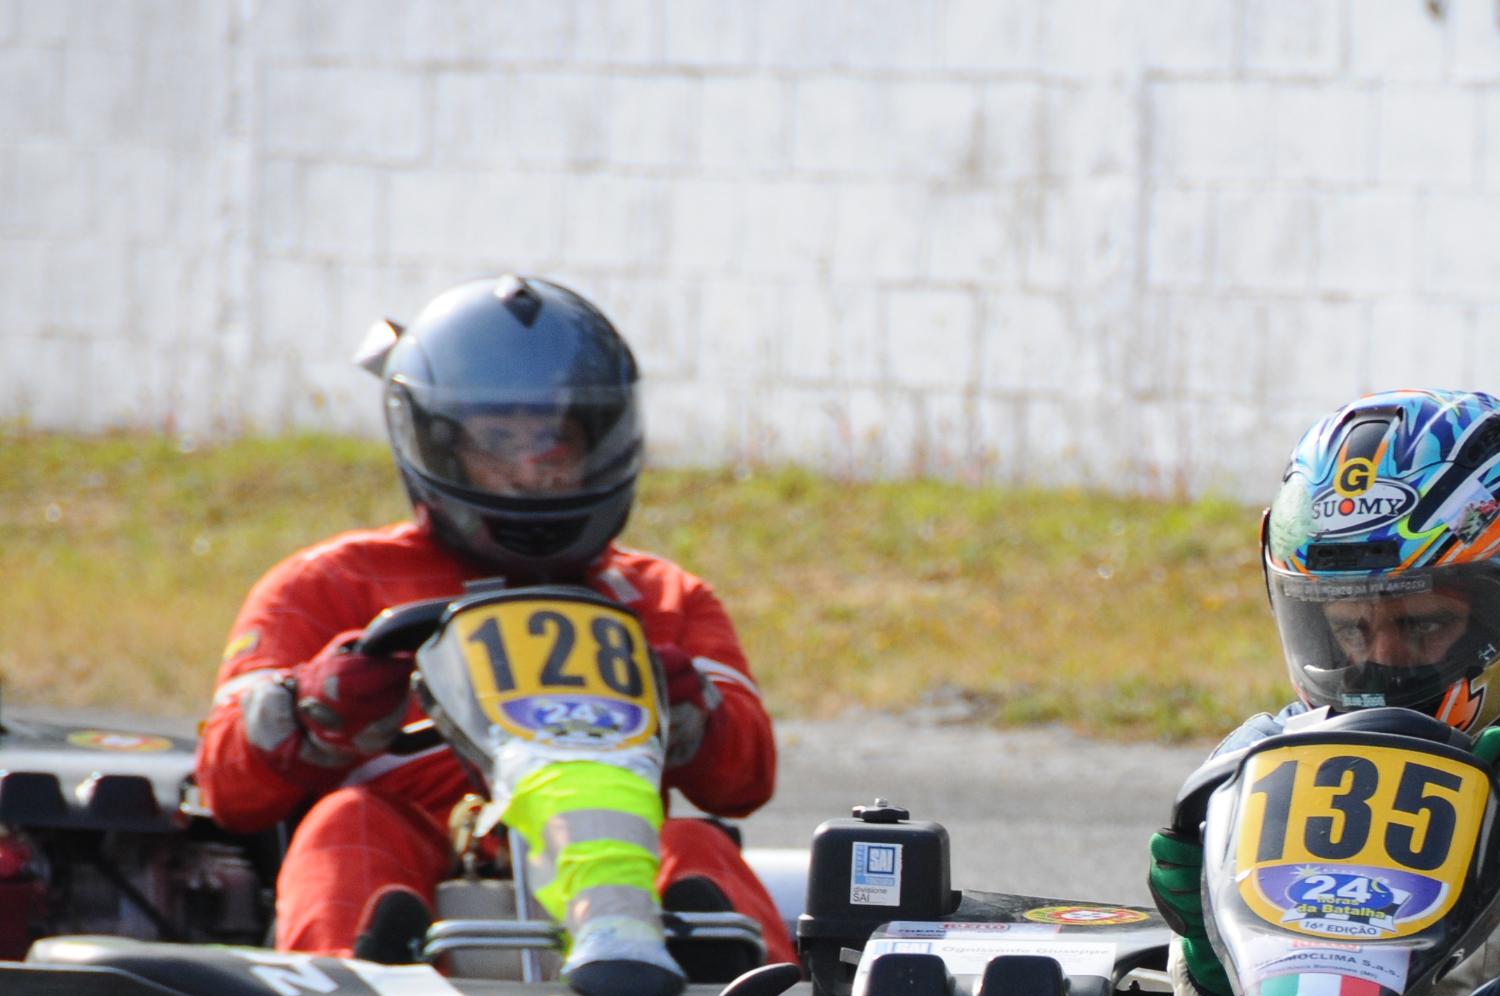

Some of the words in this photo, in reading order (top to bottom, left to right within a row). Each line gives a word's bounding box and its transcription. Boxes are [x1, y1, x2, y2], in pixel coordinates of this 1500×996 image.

[1311, 497, 1403, 520] SUOMY
[468, 609, 644, 698] 128
[544, 703, 598, 723] 24
[1251, 755, 1463, 871] 135
[1302, 875, 1372, 903] 24
[1297, 904, 1318, 914] da
[1322, 905, 1386, 920] Batalha
[1327, 924, 1378, 936] EDIÇÃO
